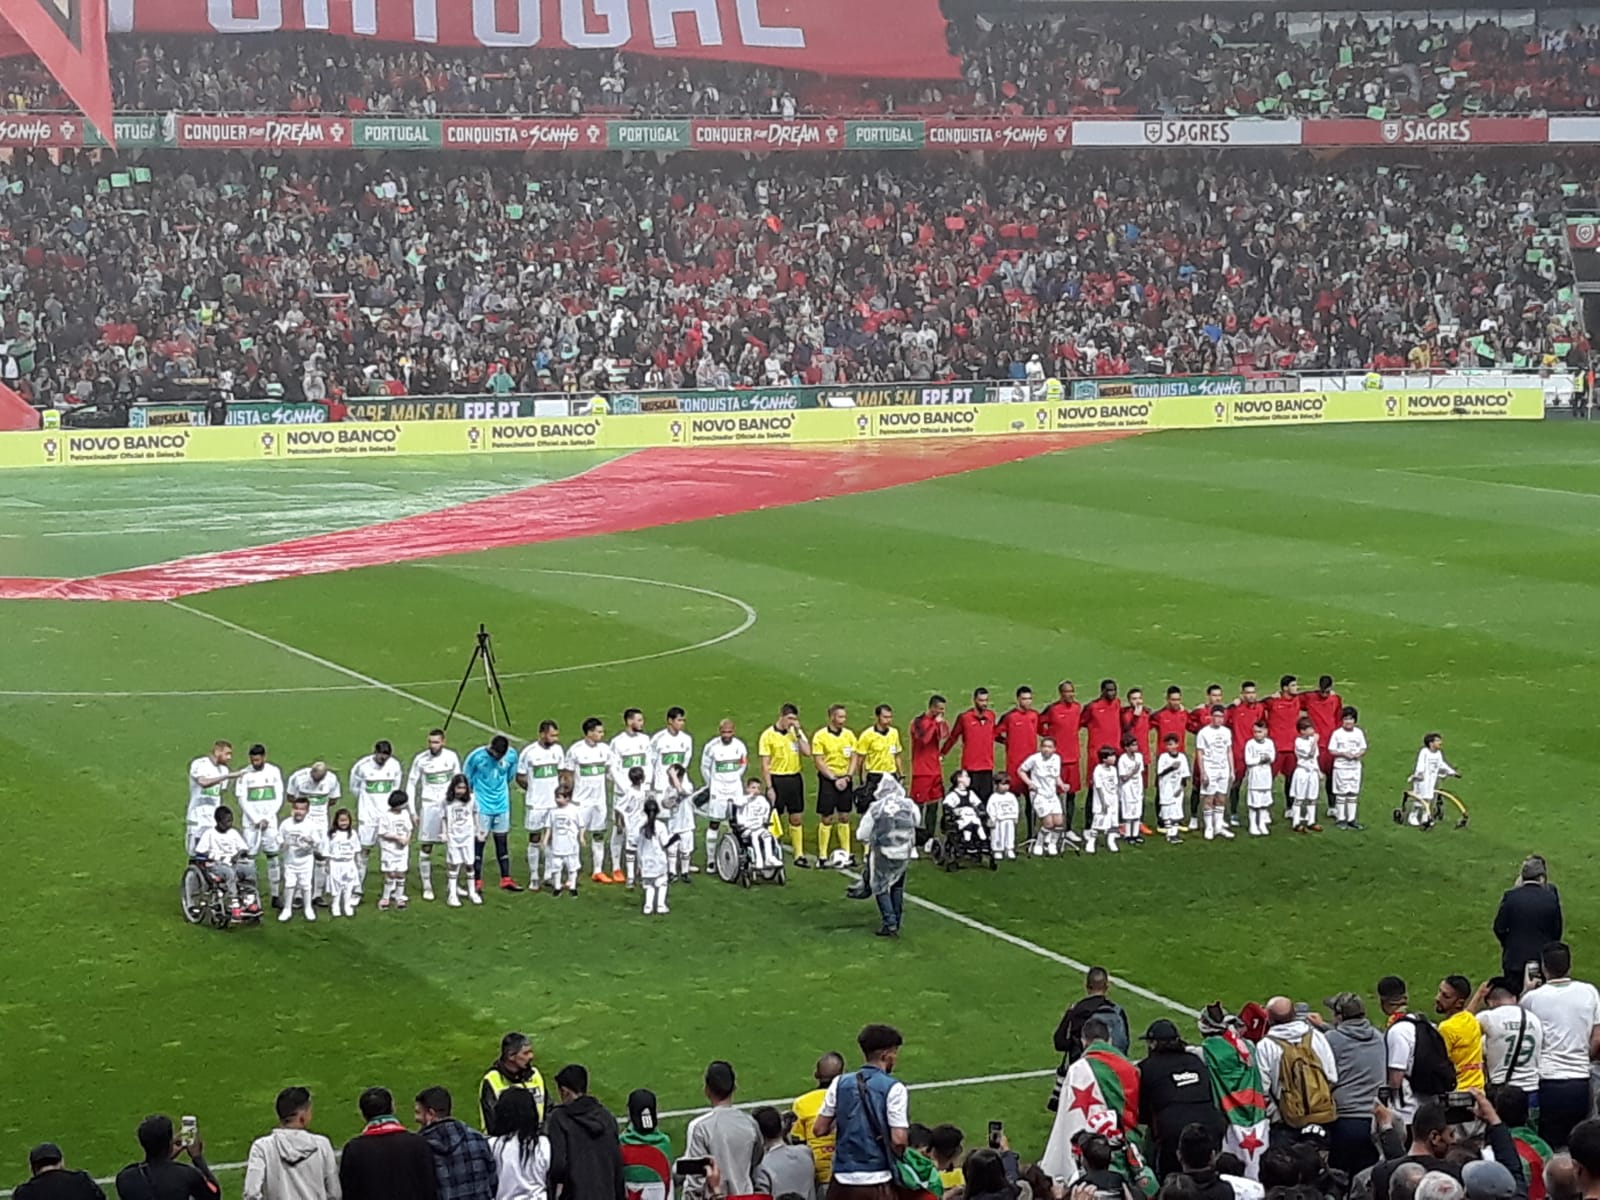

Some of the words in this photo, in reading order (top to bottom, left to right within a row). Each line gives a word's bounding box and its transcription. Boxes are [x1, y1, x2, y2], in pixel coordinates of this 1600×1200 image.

[184, 123, 247, 142] CONQUER
[265, 120, 324, 146] DREAM
[364, 125, 430, 142] PORTUGAL
[447, 126, 518, 144] CONQUISTA
[618, 126, 681, 143] PORTUGAL
[696, 126, 752, 144] CONQUER
[767, 123, 820, 147] DREAM
[856, 126, 914, 143] PORTUGAL
[930, 127, 993, 144] CONQUISTA
[1166, 122, 1230, 143] SAGRES
[1403, 119, 1471, 142] SAGRES
[1234, 400, 1273, 413] NOVO
[1275, 398, 1323, 412] BANCO
[1408, 394, 1450, 408] NOVO
[1453, 394, 1508, 407] BANCO
[390, 403, 431, 421] MAIS
[879, 412, 921, 426] NOVO
[923, 411, 974, 425] BANCO
[1057, 406, 1098, 420] NOVO
[1100, 404, 1149, 418] BANCO
[492, 424, 538, 439] NOVO
[540, 423, 596, 438] BANCO
[692, 418, 736, 433] NOVO
[738, 417, 792, 431] BANCO
[70, 436, 120, 451] NOVO
[123, 434, 185, 450] BANCO
[287, 430, 335, 445] NOVO
[338, 428, 396, 443] BANCO
